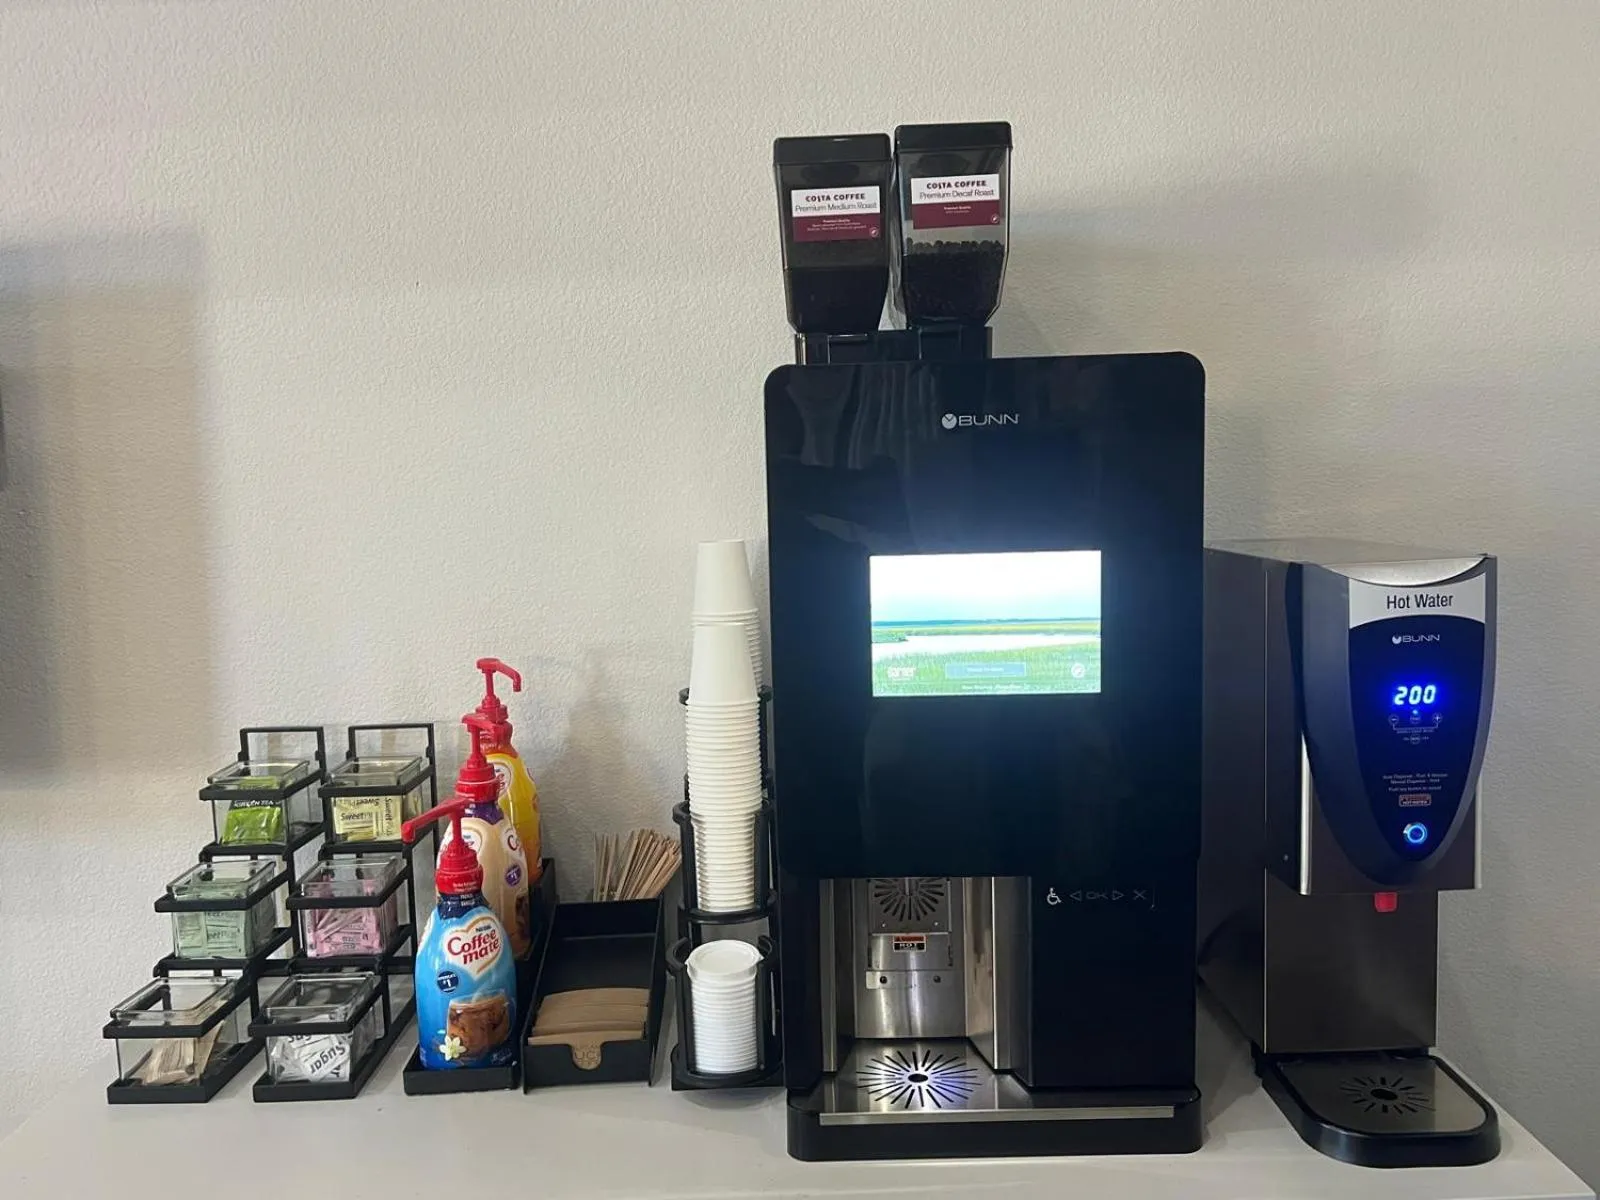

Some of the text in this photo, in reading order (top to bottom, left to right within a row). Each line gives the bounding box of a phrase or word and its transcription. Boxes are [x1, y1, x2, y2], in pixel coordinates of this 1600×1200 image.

[926, 180, 987, 190] COSTA COFFEE
[805, 193, 866, 203] COSTA COFFEE
[919, 188, 994, 200] Premium Decaf Roast
[795, 204, 826, 212] Premium
[828, 203, 857, 211] Medium
[958, 413, 1019, 426] BUNN
[1386, 593, 1454, 610] Hot Water
[1402, 634, 1440, 643] BUNN
[1393, 684, 1437, 706] 200
[447, 929, 497, 956] Coffee
[463, 938, 500, 965] mate
[309, 1044, 346, 1075] Sugar
